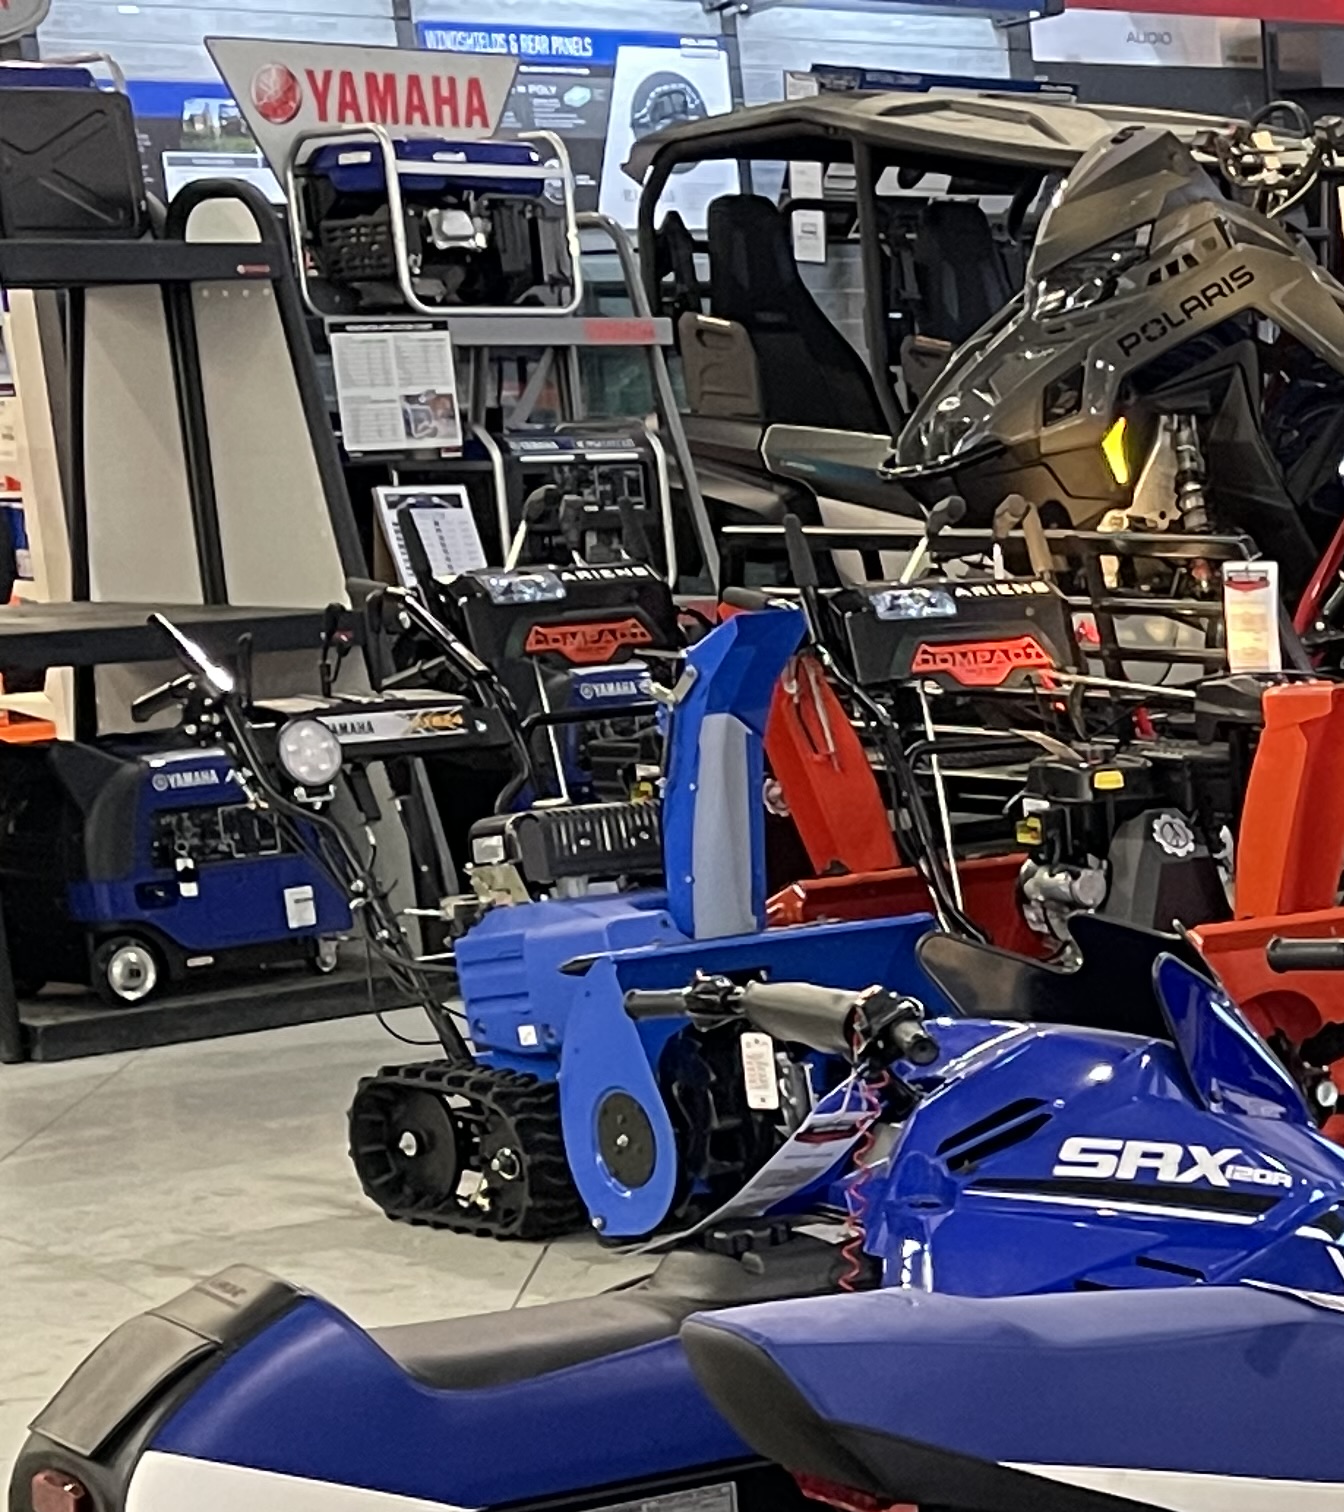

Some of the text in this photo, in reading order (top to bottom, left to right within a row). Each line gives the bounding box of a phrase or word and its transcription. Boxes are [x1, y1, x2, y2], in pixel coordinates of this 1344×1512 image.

[424, 30, 507, 54] WINDSHIELDS
[520, 34, 549, 56] REAR
[305, 68, 490, 129] YAMAHA
[1116, 264, 1255, 358] POLARIS
[561, 564, 649, 582] ARIENS
[954, 580, 1050, 598] ARIENS
[532, 624, 648, 648] COMPACT
[916, 642, 1046, 667] COMPACT
[593, 681, 637, 698] YAMAHA
[167, 768, 220, 788] YAMAHA
[1052, 1136, 1243, 1188] SRX
